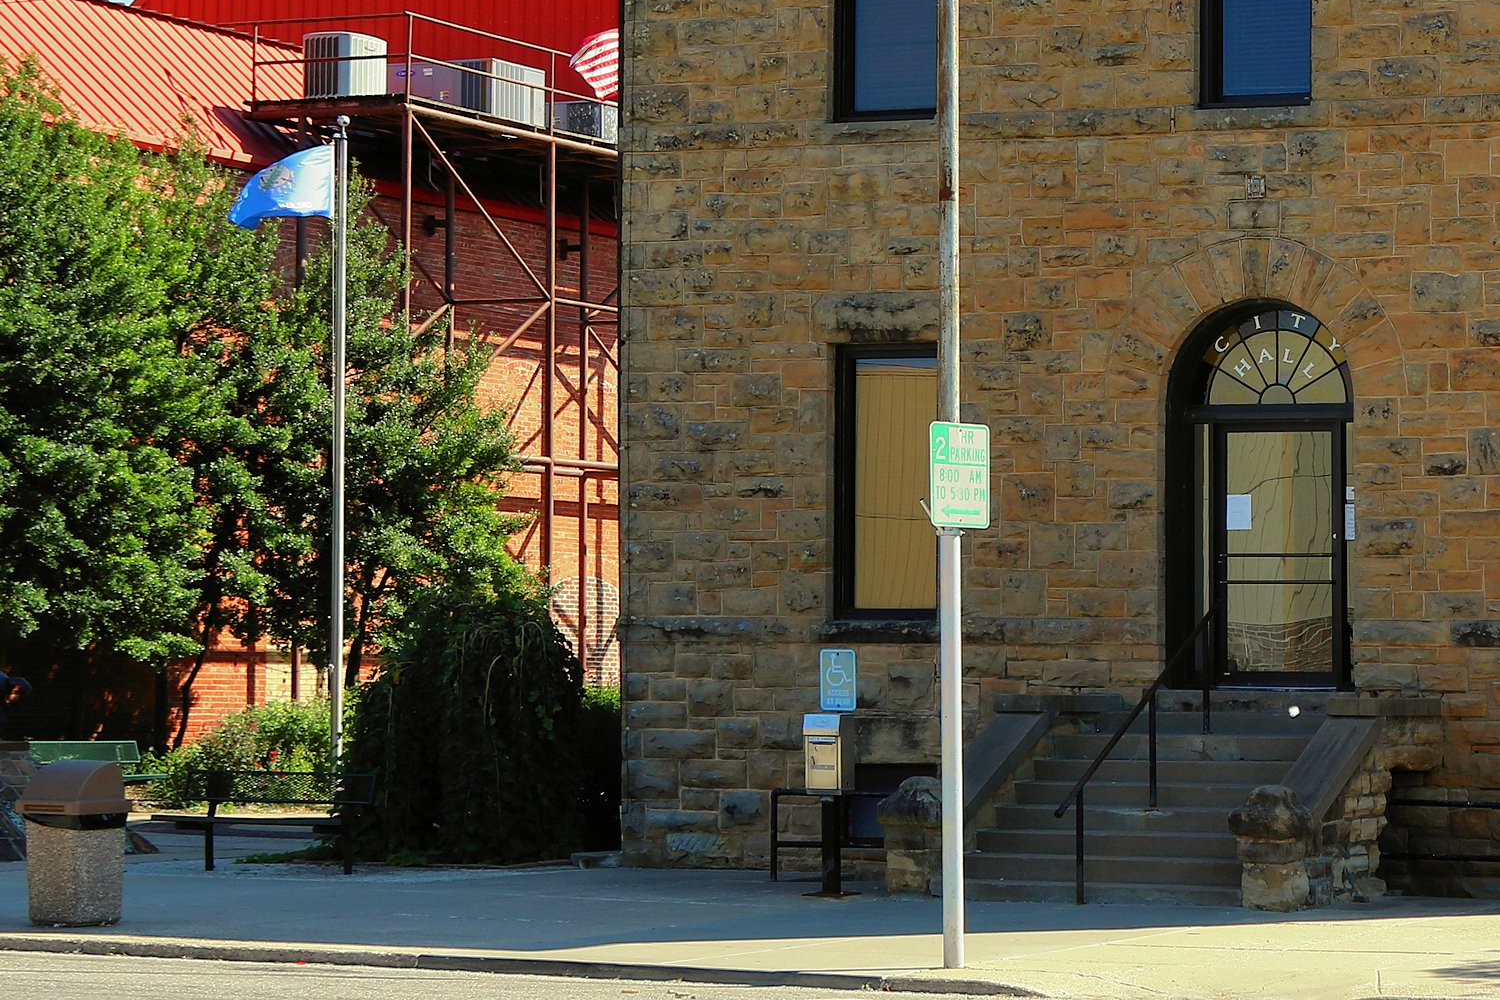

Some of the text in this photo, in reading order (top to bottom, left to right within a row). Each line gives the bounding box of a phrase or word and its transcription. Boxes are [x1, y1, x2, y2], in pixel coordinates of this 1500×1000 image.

[1214, 313, 1340, 353] CITY
[1234, 348, 1314, 379] HALL
[961, 430, 974, 444] HR
[935, 436, 946, 460] 2
[950, 447, 985, 462] PARKING
[940, 468, 982, 484] 8:00 AM
[936, 485, 985, 502] TO 5:30 PM
[827, 689, 849, 697] ACCESS
